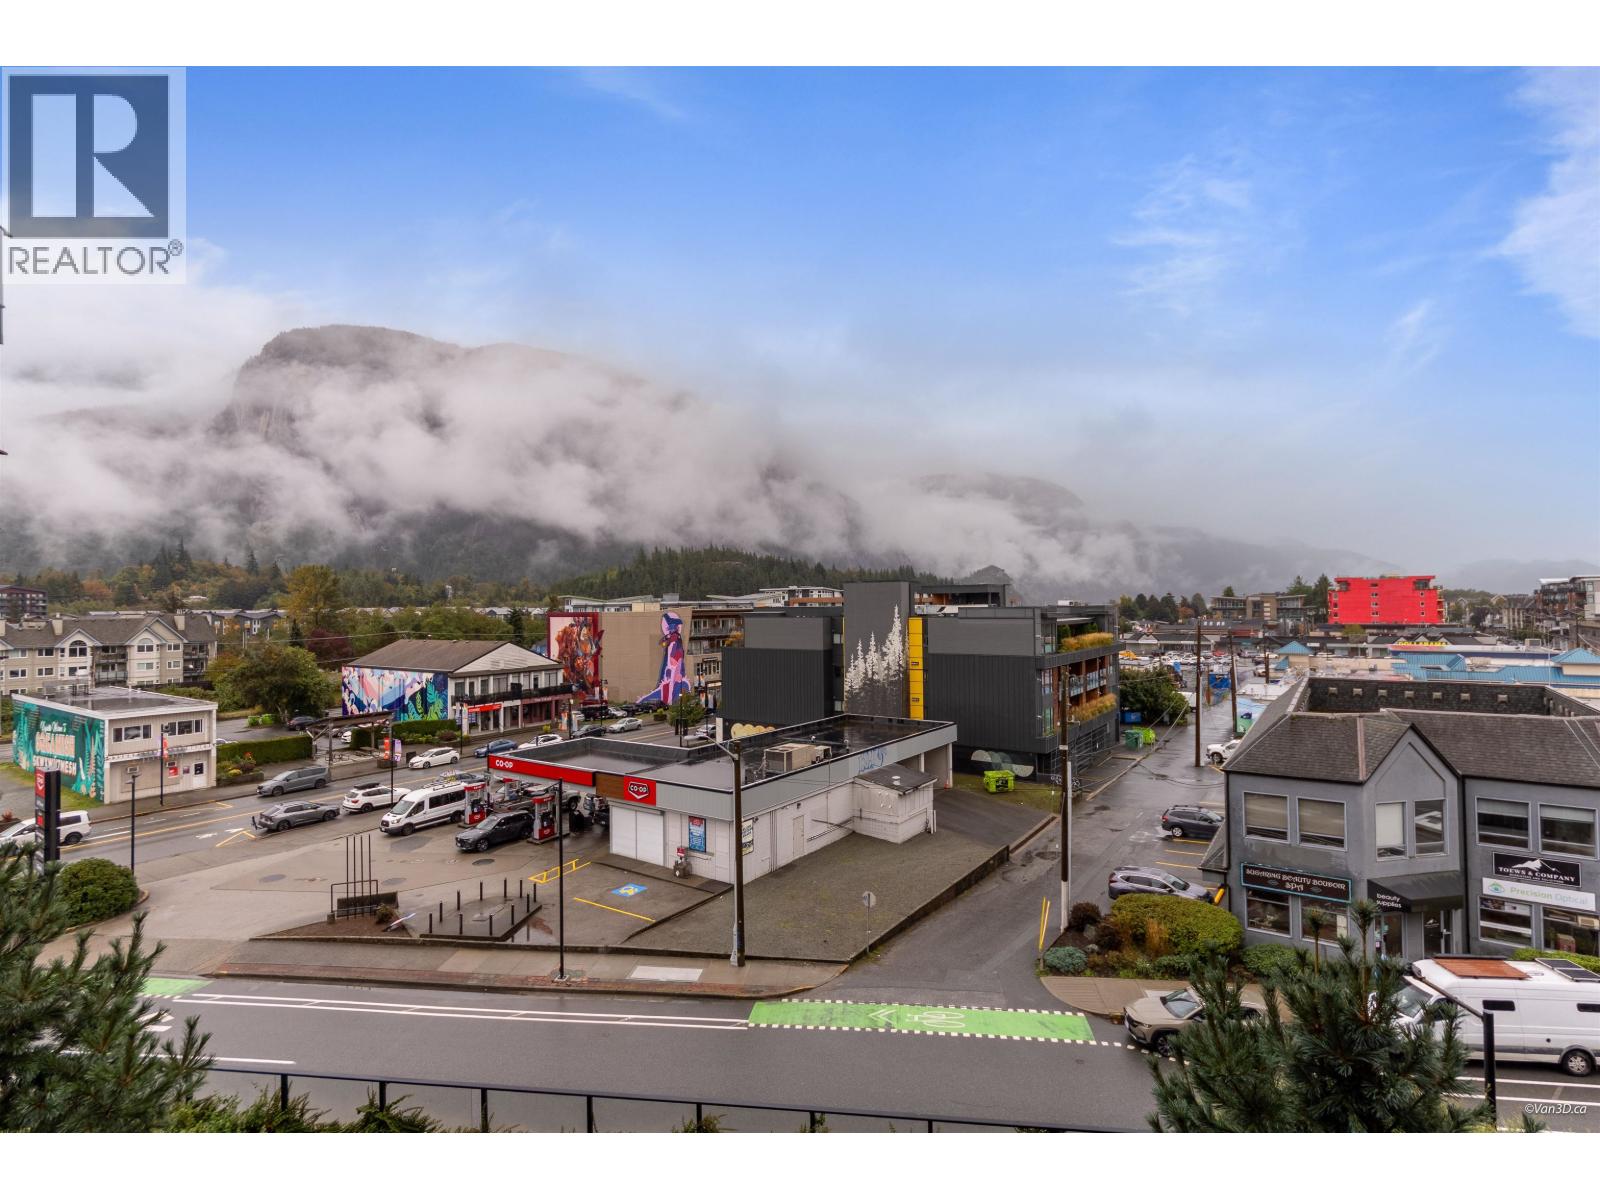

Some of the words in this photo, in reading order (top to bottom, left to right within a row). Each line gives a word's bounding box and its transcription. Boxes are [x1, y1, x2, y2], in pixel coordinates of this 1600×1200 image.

[1282, 874, 1312, 885] BEAUTY
[1498, 867, 1526, 875] TOEWS
[1535, 871, 1576, 882] COMPANY
[1284, 882, 1304, 892] SPA
[1376, 893, 1401, 903] beauty
[1510, 886, 1553, 900] Precision
[1554, 893, 1588, 905] Optical
